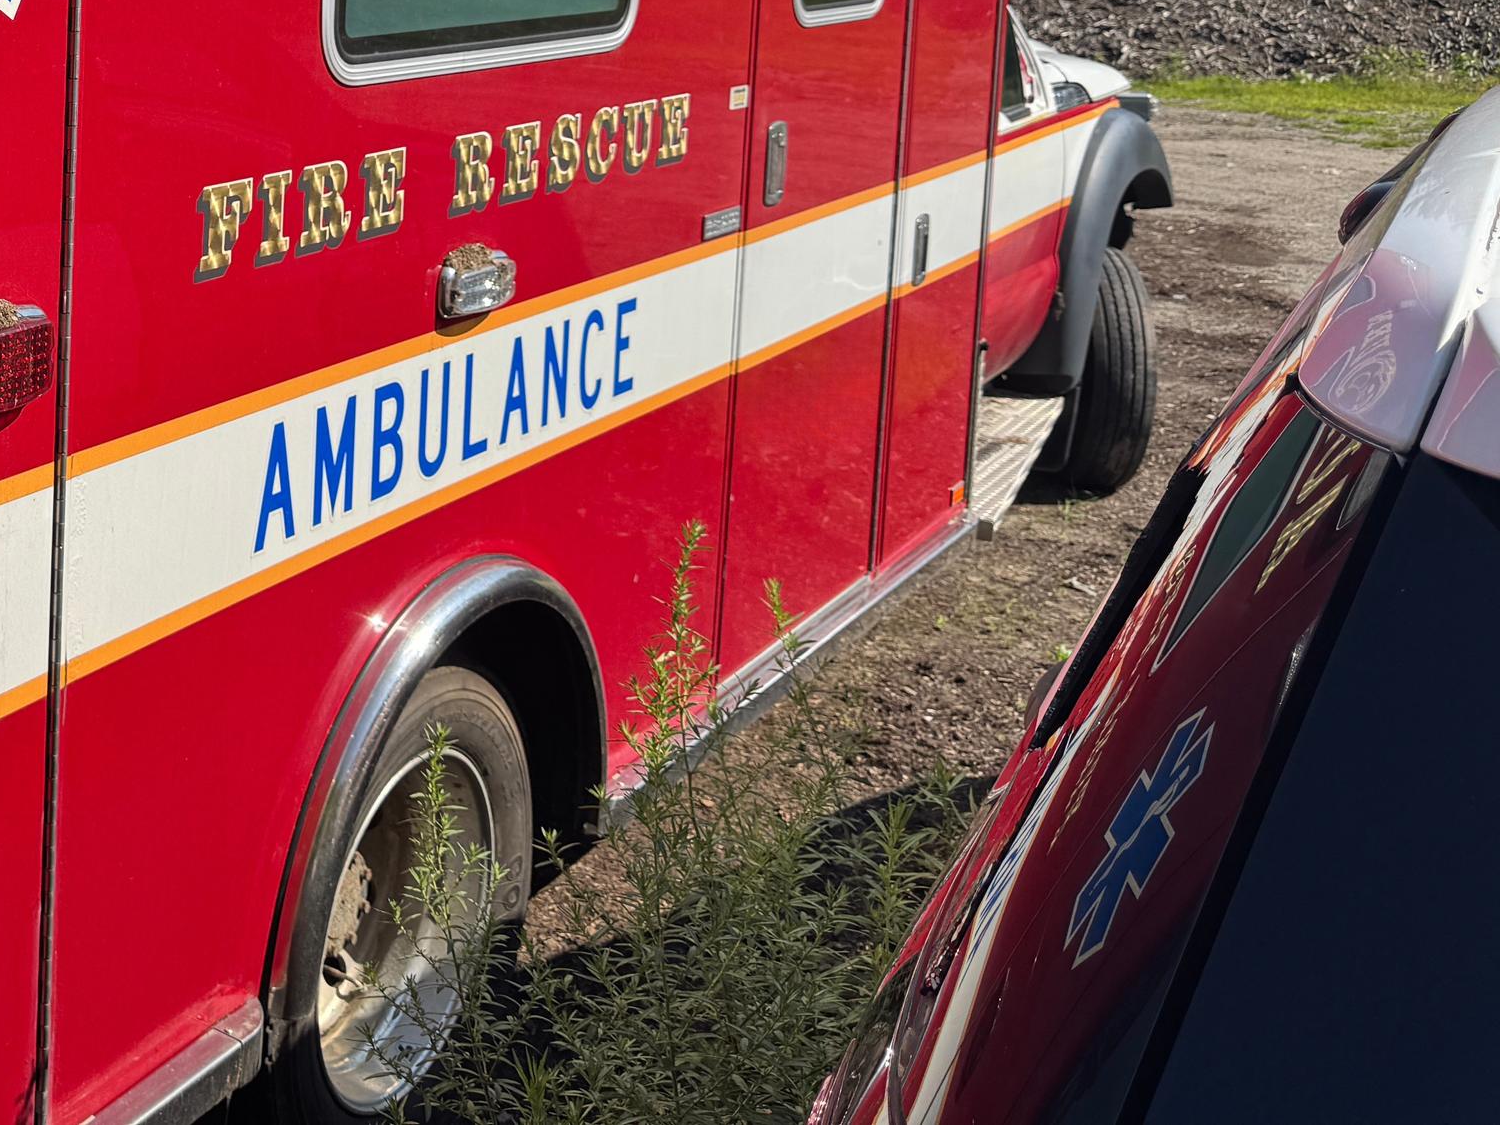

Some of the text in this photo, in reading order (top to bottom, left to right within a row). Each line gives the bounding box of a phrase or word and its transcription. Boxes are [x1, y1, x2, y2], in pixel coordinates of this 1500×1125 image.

[194, 93, 691, 283] FIRE RESCUE
[253, 297, 638, 554] AMBULANCE
